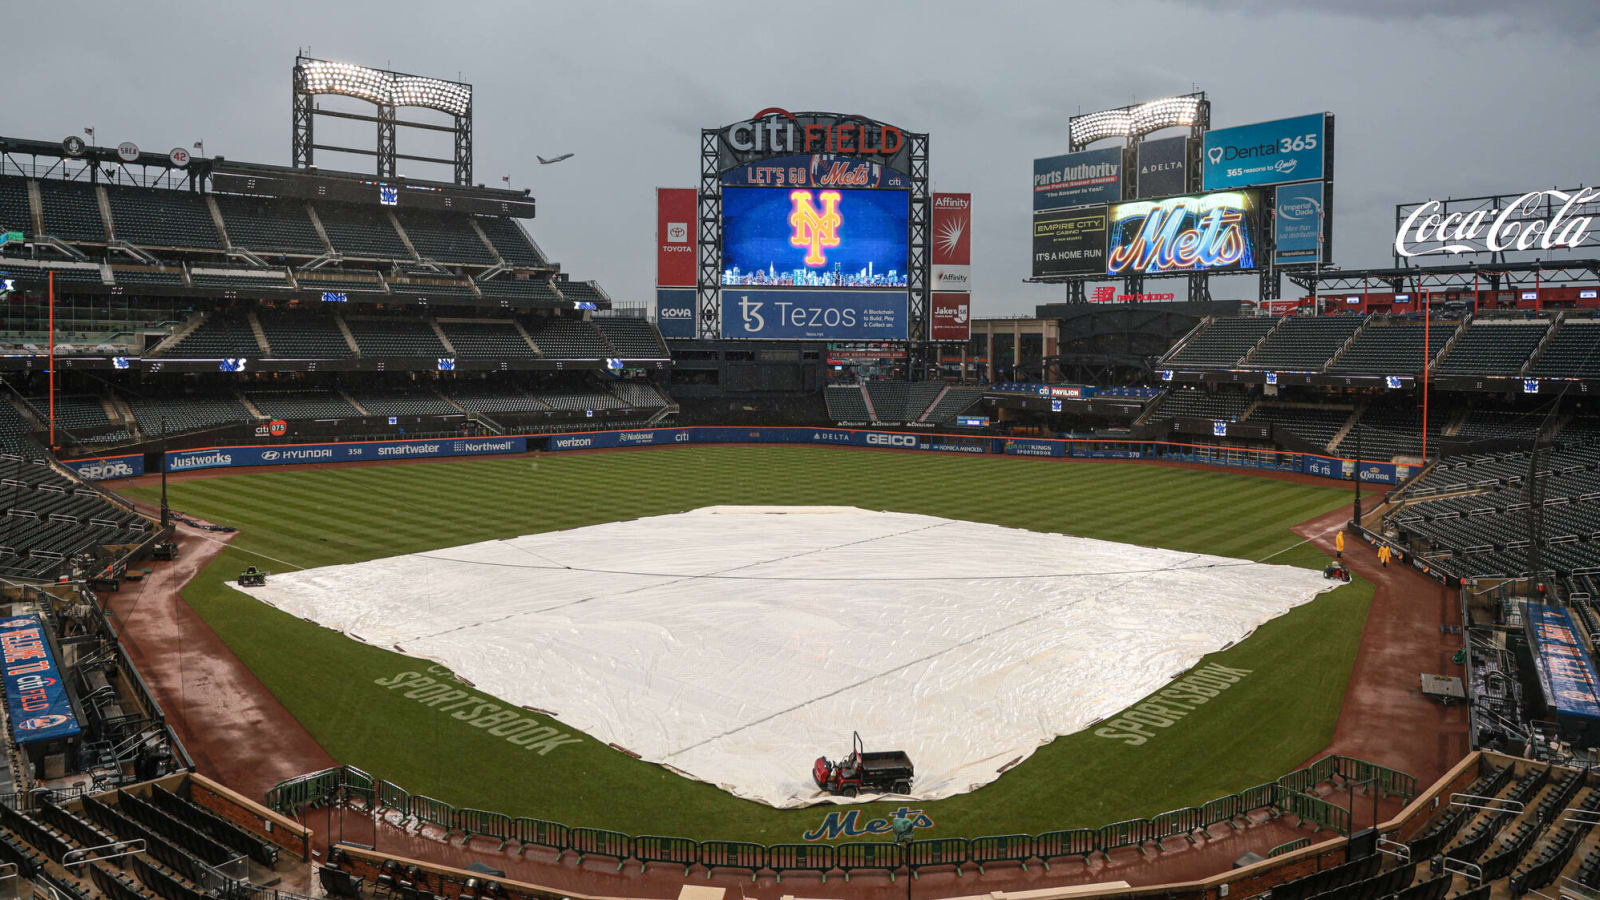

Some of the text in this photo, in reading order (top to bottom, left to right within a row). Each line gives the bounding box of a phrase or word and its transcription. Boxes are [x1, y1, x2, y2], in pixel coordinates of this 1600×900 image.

[729, 115, 903, 153] citi FIELD
[173, 152, 188, 161] 42
[1150, 161, 1183, 172] DELTA
[748, 161, 869, 185] LET'S GO Mets
[1034, 163, 1118, 186] Parts Authority
[1226, 168, 1243, 177] 365
[889, 178, 901, 186] citi
[935, 197, 968, 208] Affinity
[1037, 220, 1100, 232] EMPIRE CITY
[1395, 187, 1600, 257] Coca-Cola
[1108, 204, 1244, 272] Mets
[1036, 249, 1102, 261] IT'S A HOME RUN
[943, 274, 967, 283] Affinity
[1117, 294, 1134, 302] new
[1136, 292, 1175, 302] balance
[661, 308, 692, 317] GOYA
[774, 302, 856, 327] Tezos
[255, 425, 269, 433] citi
[627, 432, 653, 441] National
[675, 431, 689, 442] citi
[822, 433, 850, 441] DELTA
[866, 433, 916, 447] GEICO
[465, 441, 511, 452] Northwell
[556, 437, 591, 448] verizon
[283, 449, 332, 459] HYUNDAI
[378, 443, 440, 456] smartwater
[170, 453, 232, 468] Justworks
[1360, 470, 1389, 480] Corona
[1094, 662, 1254, 746] SPORTSBOOK
[373, 671, 583, 756] SPORTSBOOK
[803, 807, 936, 841] Mets
